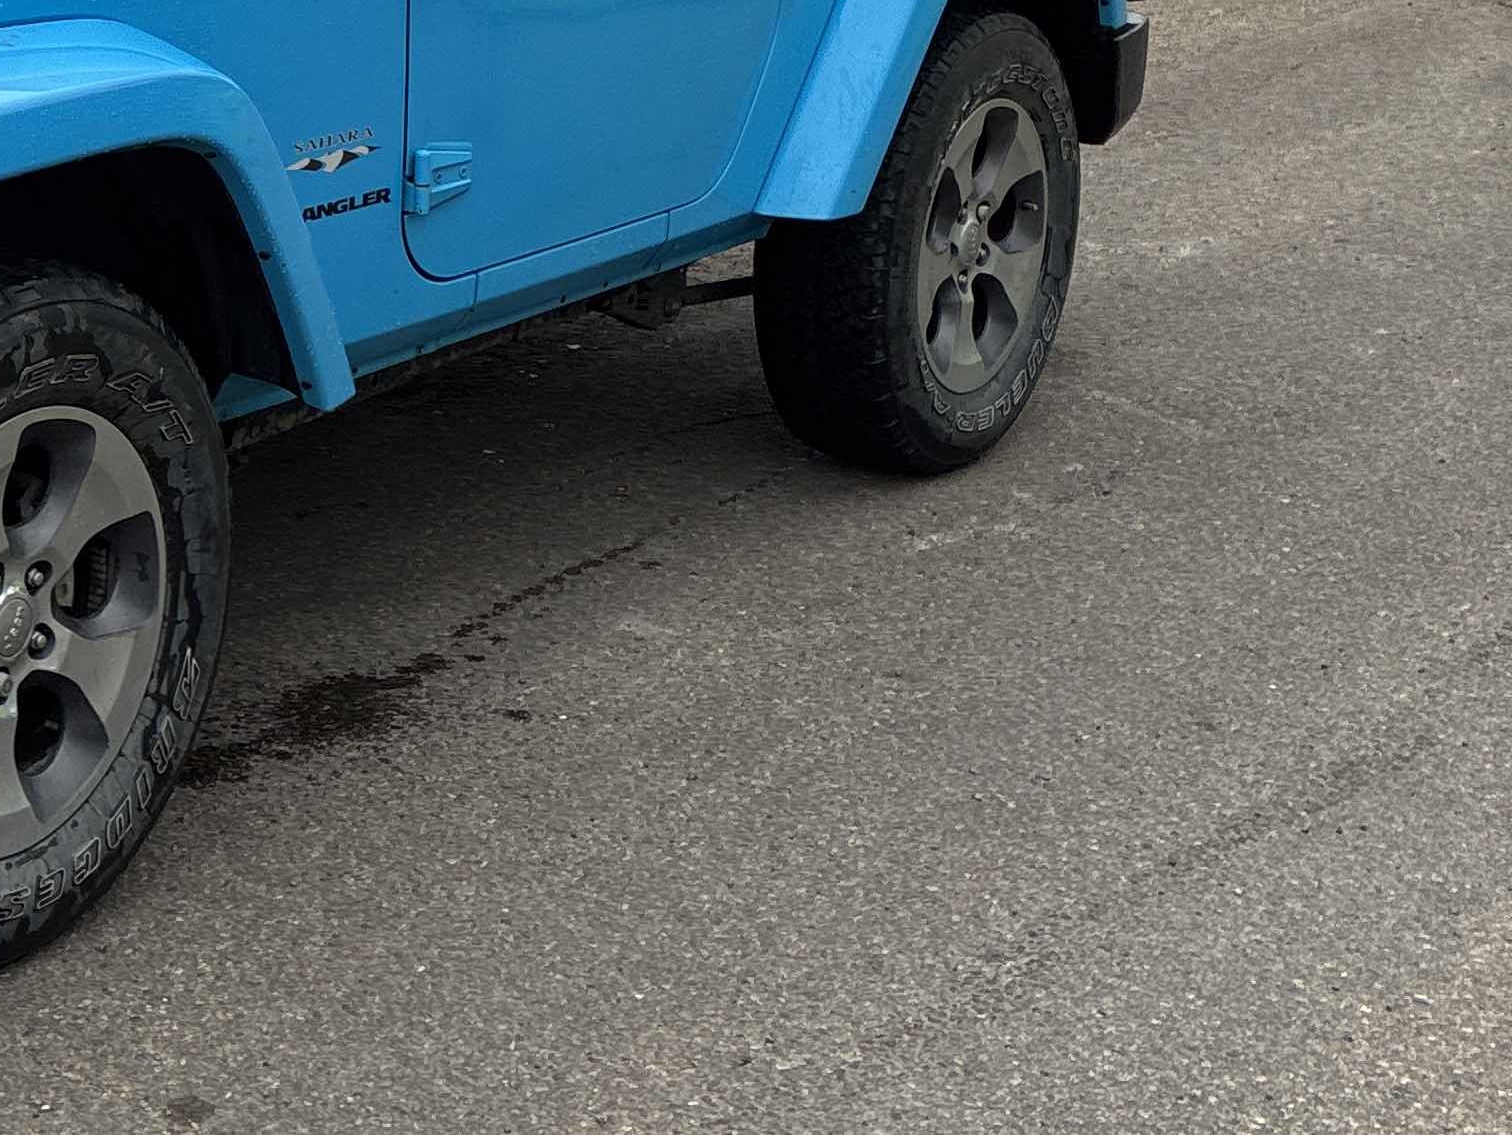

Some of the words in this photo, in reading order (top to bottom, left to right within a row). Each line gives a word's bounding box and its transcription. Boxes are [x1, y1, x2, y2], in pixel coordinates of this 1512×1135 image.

[294, 125, 376, 154] SAHARA
[302, 187, 392, 223] ANGLER
[957, 295, 1058, 432] DUELER
